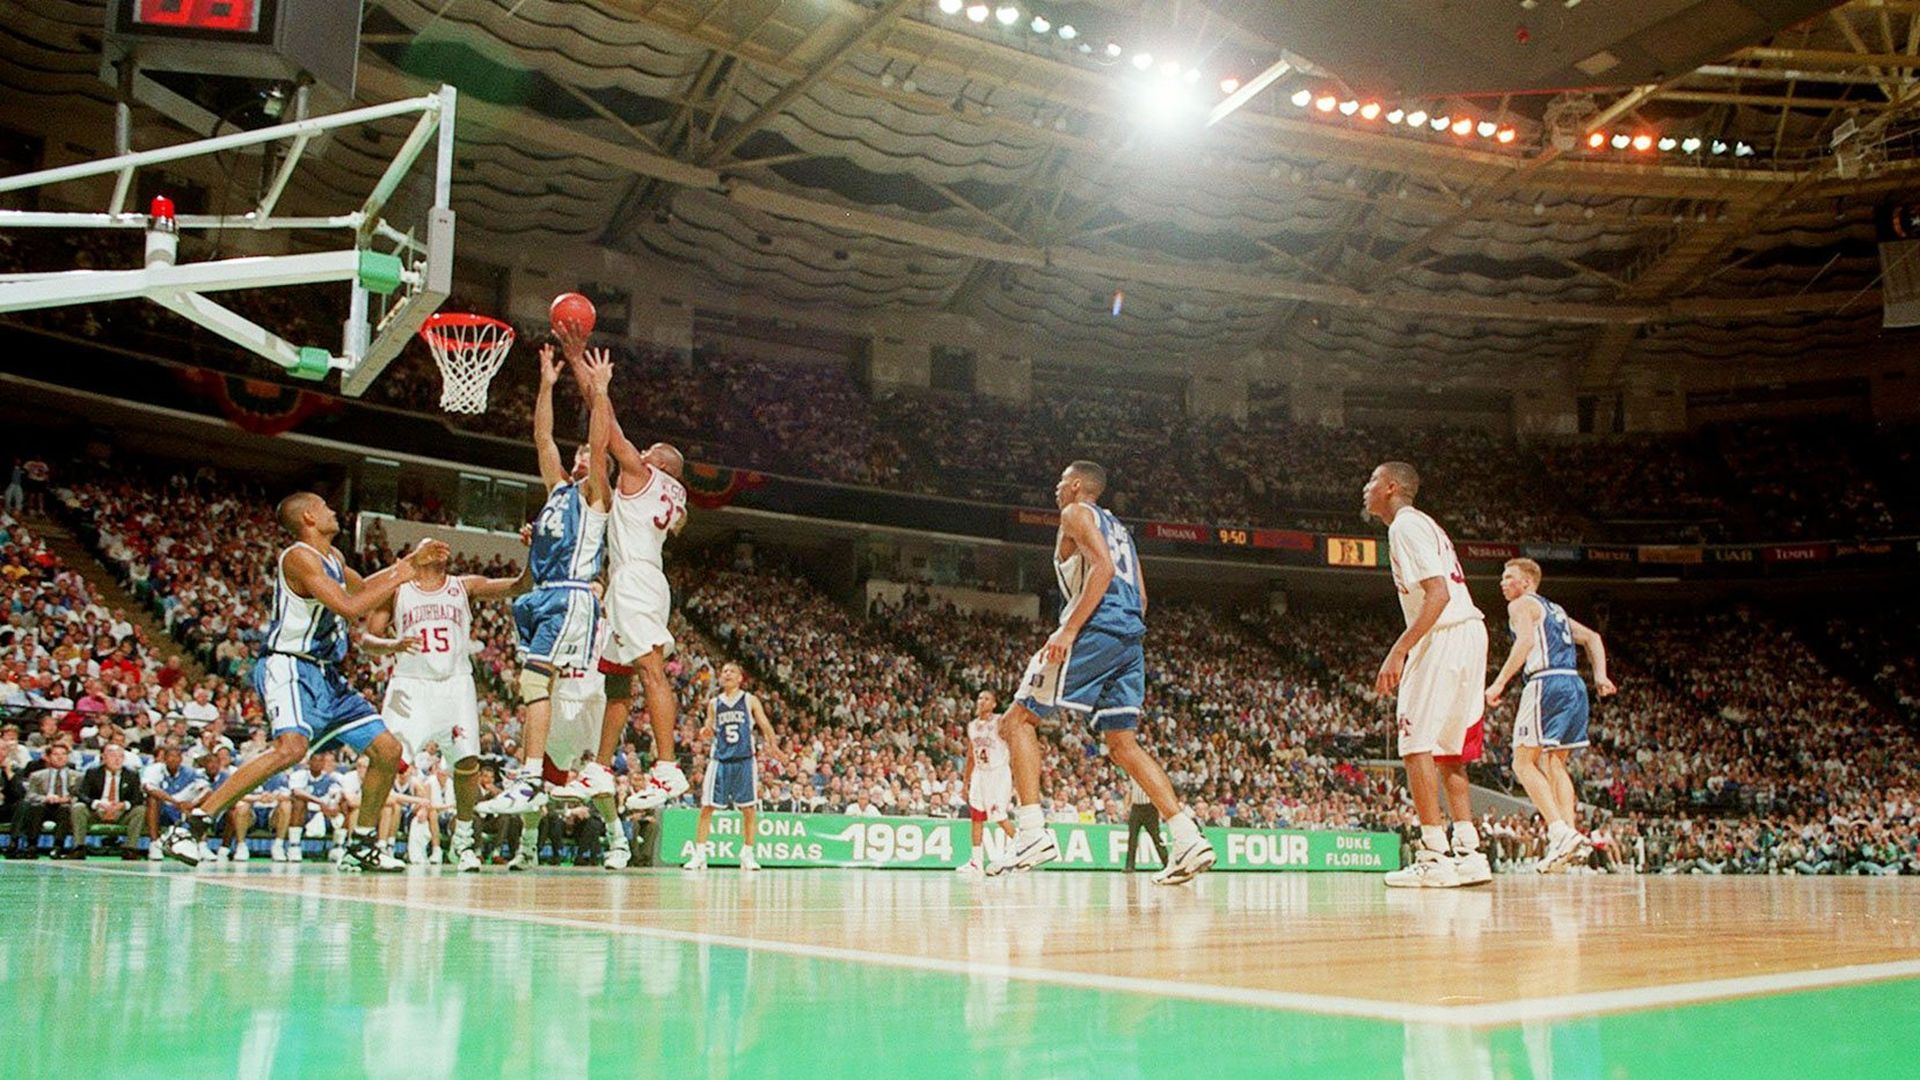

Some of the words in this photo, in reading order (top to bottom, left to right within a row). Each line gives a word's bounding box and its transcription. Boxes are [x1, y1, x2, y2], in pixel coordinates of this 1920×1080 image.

[1157, 525, 1198, 540] INDIANA
[1776, 548, 1816, 560] TEMPLE
[419, 626, 450, 653] 15
[718, 710, 746, 726] DUKE
[725, 723, 740, 743] 5
[708, 816, 807, 837] RIONA
[838, 823, 953, 862] 1994
[1227, 833, 1309, 866] FOUR
[1335, 836, 1372, 850] DUKE
[1325, 853, 1382, 867] FLORIDA
